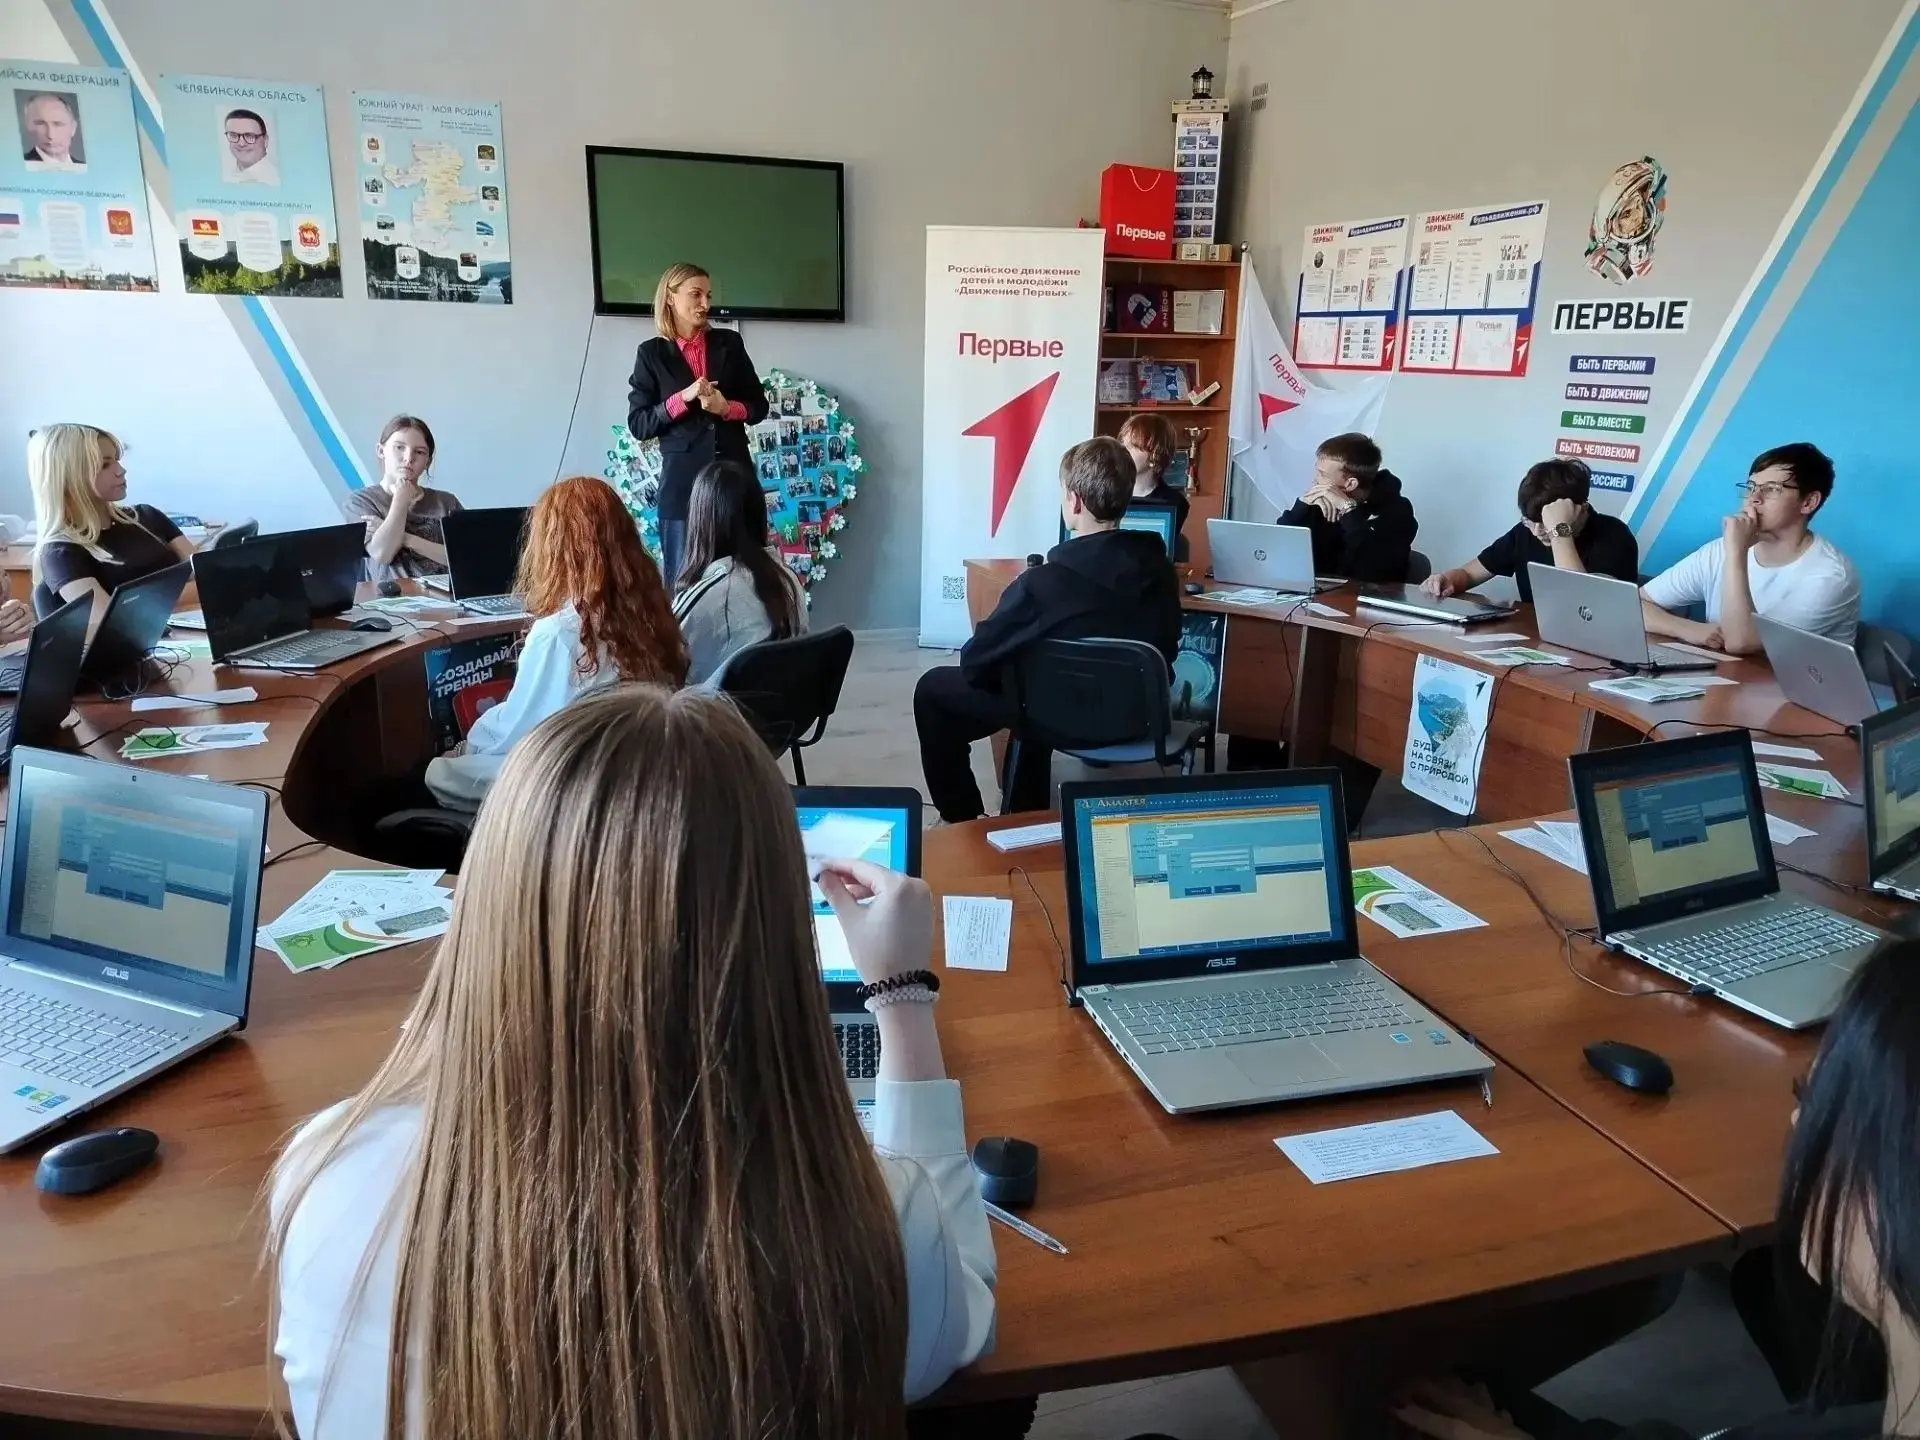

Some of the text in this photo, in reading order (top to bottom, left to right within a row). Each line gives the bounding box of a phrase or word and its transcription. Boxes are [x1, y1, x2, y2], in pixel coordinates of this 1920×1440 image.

[49, 73, 120, 87] ФЕДЕРАЦИЯ
[175, 83, 307, 102] ЧЕЛЯБИНСКАЯ ОБЛАСТЬ
[358, 98, 398, 110] ЮЖНЫЙ
[400, 102, 423, 112] УРАЛ
[432, 105, 452, 114] МОЯ
[455, 106, 493, 117] РОДИНА
[1425, 212, 1465, 225] ДВИЖЕНИЕ
[1116, 223, 1167, 241] Первые
[1313, 225, 1344, 236] ДВИЖЕНИЕ
[1424, 224, 1452, 234] ПЕРВЫХ
[1312, 235, 1334, 244] ПЕРВЫХ
[947, 264, 1081, 276] Российское движение
[960, 276, 994, 285] детей
[1006, 278, 1068, 288] молодёжи
[954, 286, 1020, 296] «Движение
[1554, 300, 1688, 330] ПЕРВЫЕ
[958, 332, 1064, 363] Первые
[1577, 358, 1646, 372] БЫТЬ ПЕРВЫМИ
[1566, 386, 1649, 401] БЫТЬ В ДВИЖЕНИИ
[1572, 414, 1632, 429] БЫТЬ ВМЕСТЕ
[1559, 441, 1636, 460] БЫТЬ ЧЕЛОВЕКОМ
[435, 646, 512, 685] СОЗДАВАЙ
[435, 667, 494, 698] ТРЕНДЫ
[1411, 750, 1456, 771] НА СВЯЗИ
[1410, 761, 1417, 769] С
[1418, 763, 1469, 785] ПРИРОДОЙ
[1206, 957, 1237, 968] ASUS
[101, 966, 130, 981] ASUS
